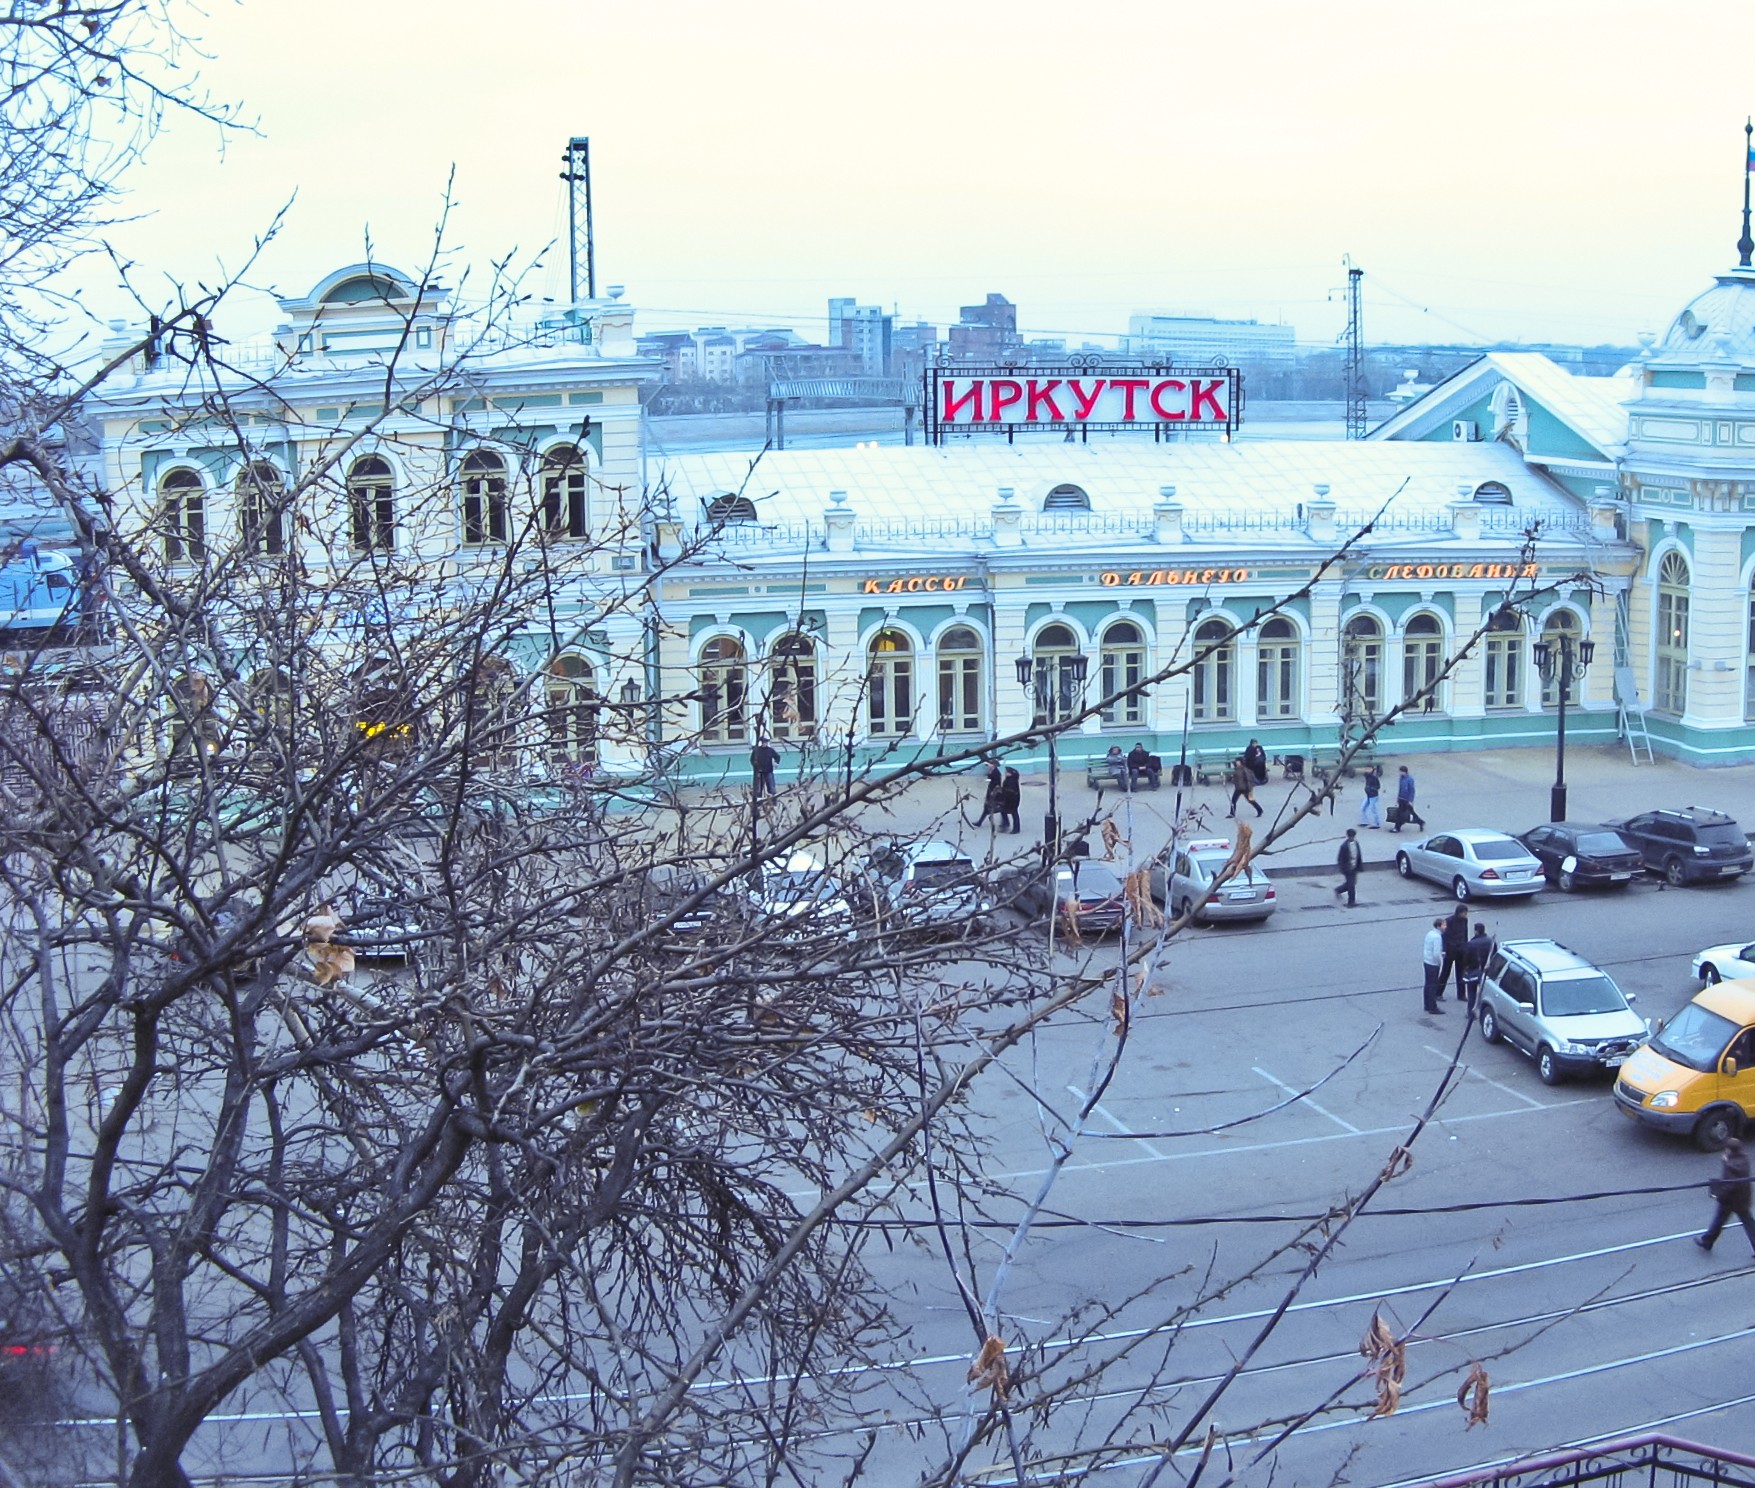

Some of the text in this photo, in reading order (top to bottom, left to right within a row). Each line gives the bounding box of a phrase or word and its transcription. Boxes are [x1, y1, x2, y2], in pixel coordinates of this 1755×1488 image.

[942, 379, 1228, 421] ИРКУТСК
[863, 576, 967, 594] КАССЫ
[1101, 568, 1249, 587] ДАЛЬНЕГО
